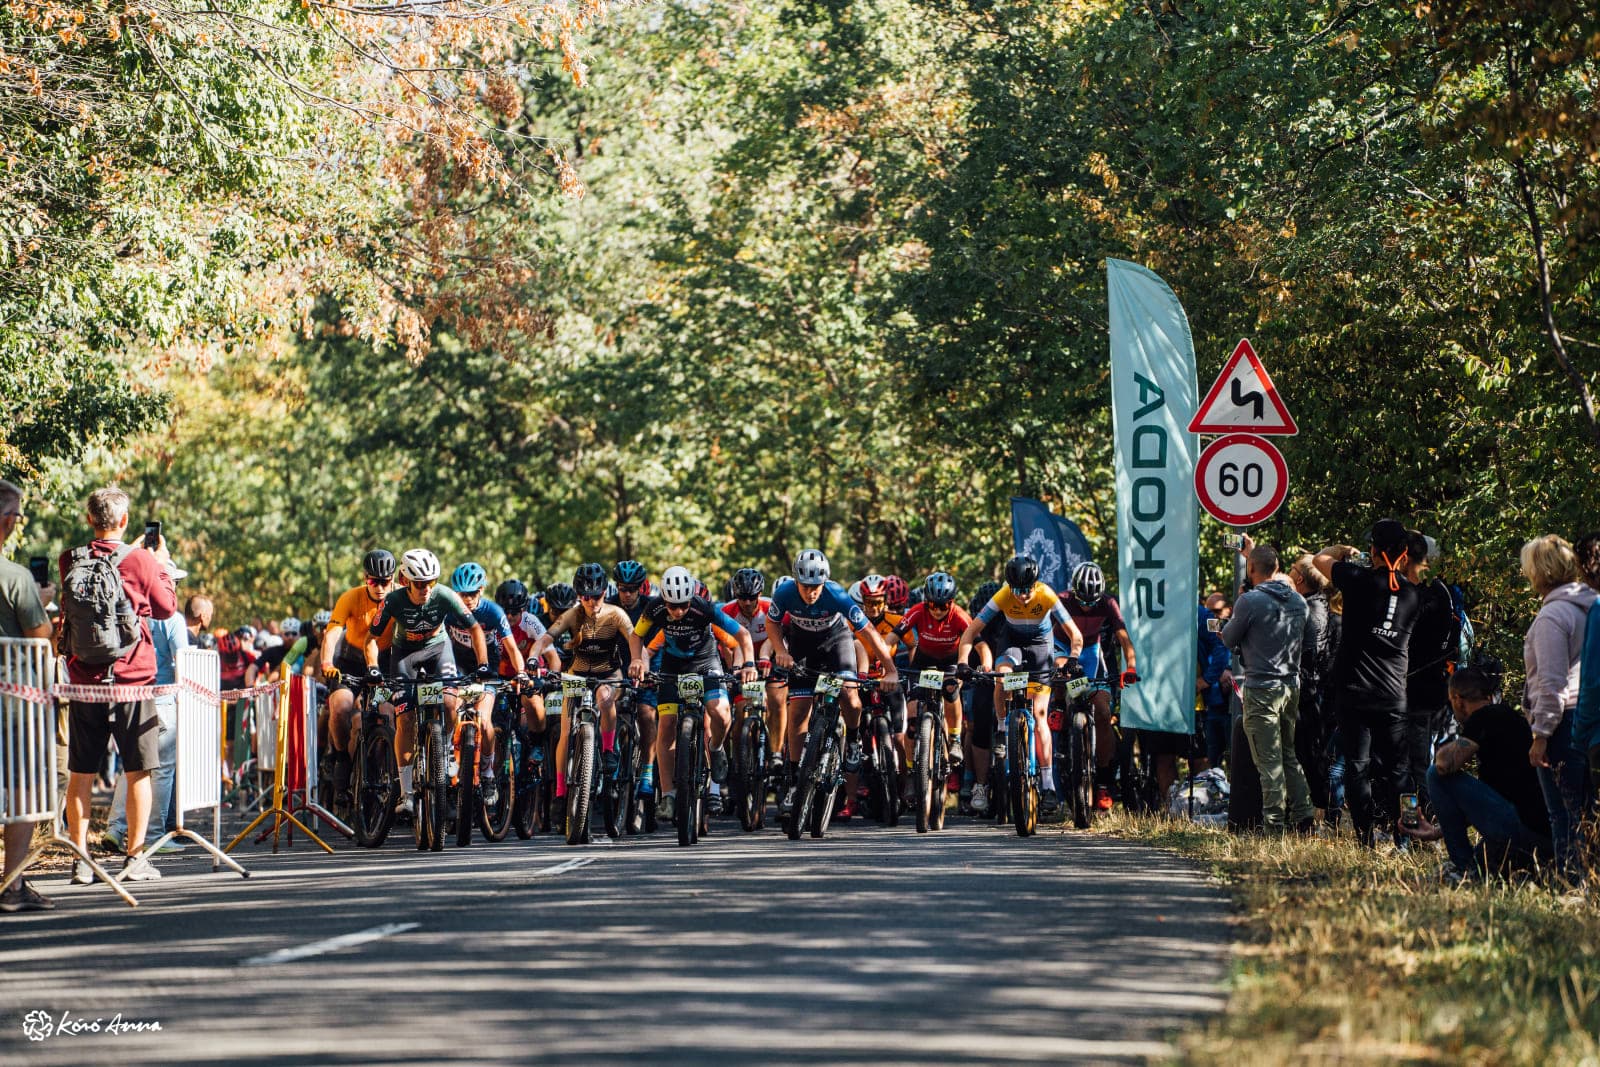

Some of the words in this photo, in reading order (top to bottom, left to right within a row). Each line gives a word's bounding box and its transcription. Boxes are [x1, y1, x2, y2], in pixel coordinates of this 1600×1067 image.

[1219, 462, 1263, 498] 60
[1371, 627, 1397, 637] STAFF
[682, 681, 699, 690] 466
[421, 686, 439, 696] 326
[548, 699, 562, 707] 303
